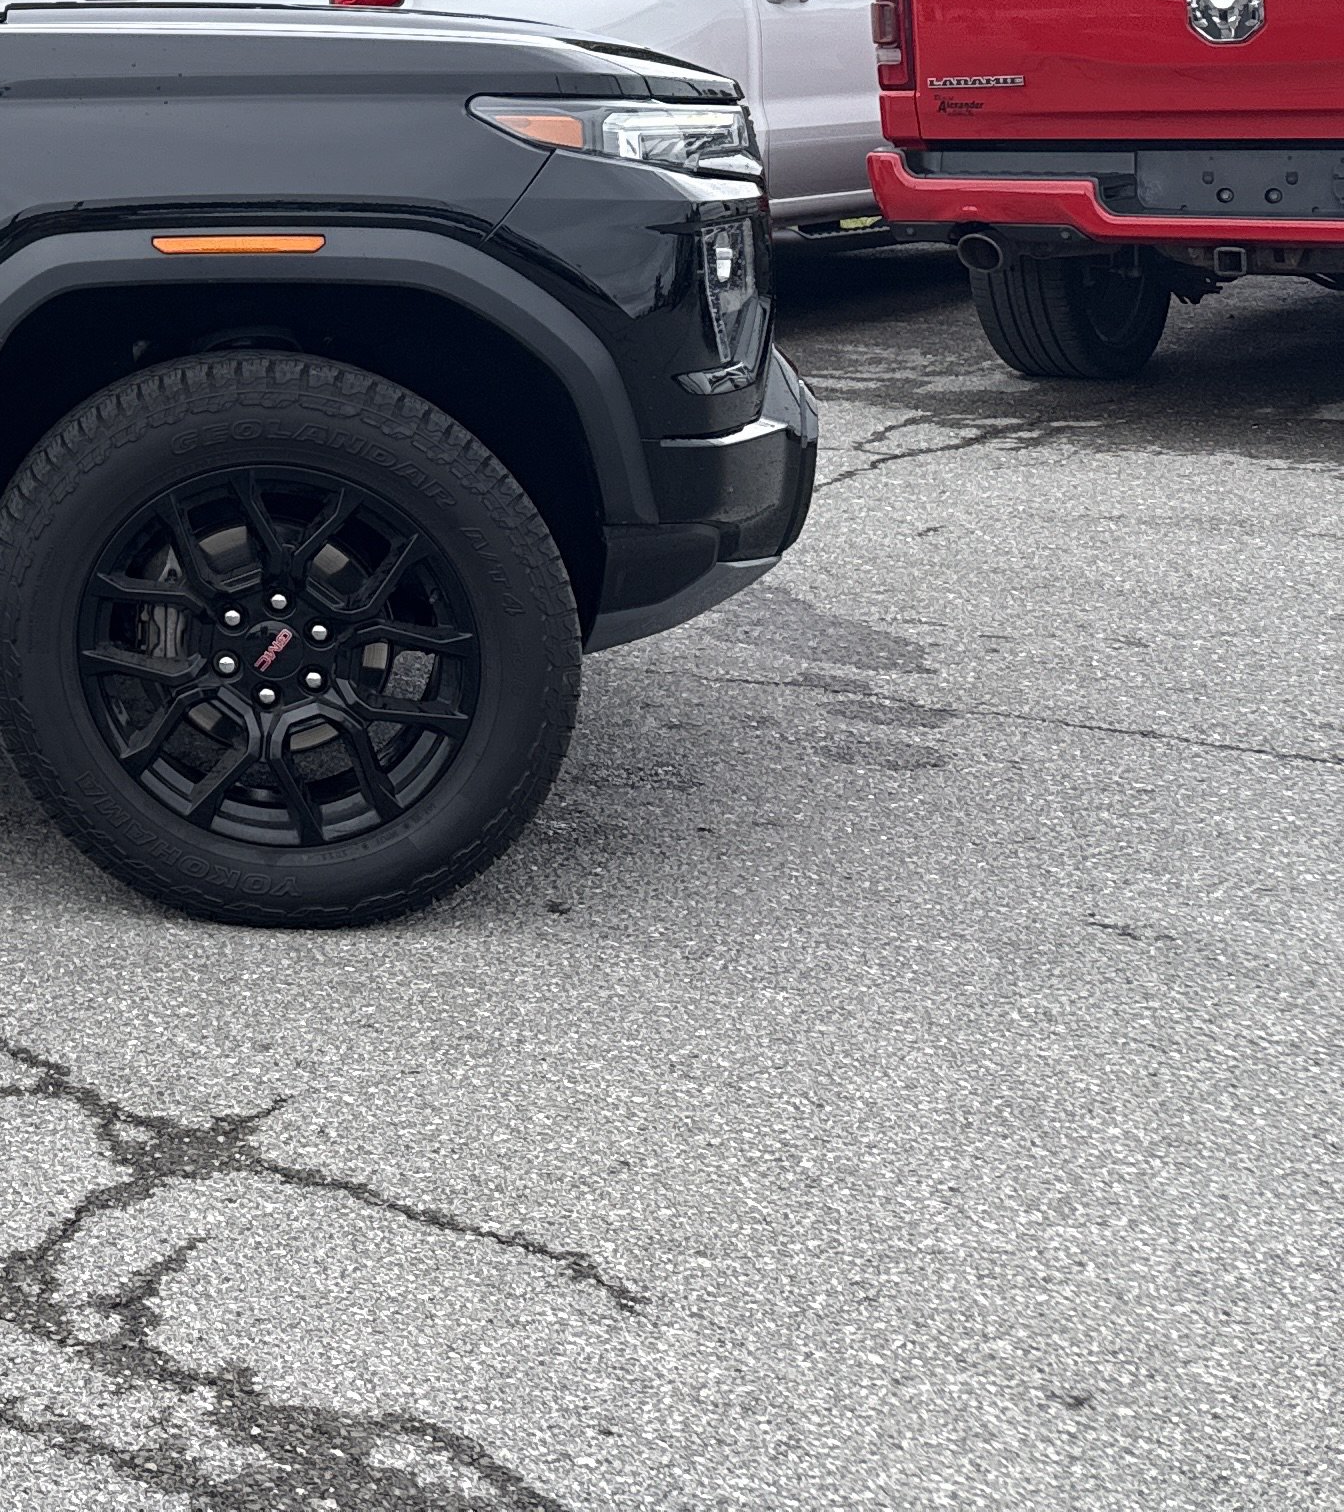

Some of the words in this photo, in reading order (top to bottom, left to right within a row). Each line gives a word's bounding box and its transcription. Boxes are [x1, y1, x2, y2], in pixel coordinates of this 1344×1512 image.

[928, 76, 1023, 87] LARAMIE
[171, 419, 457, 509] GEOLANDAR
[254, 628, 293, 672] GMC
[74, 770, 303, 898] YOKOHAMA
